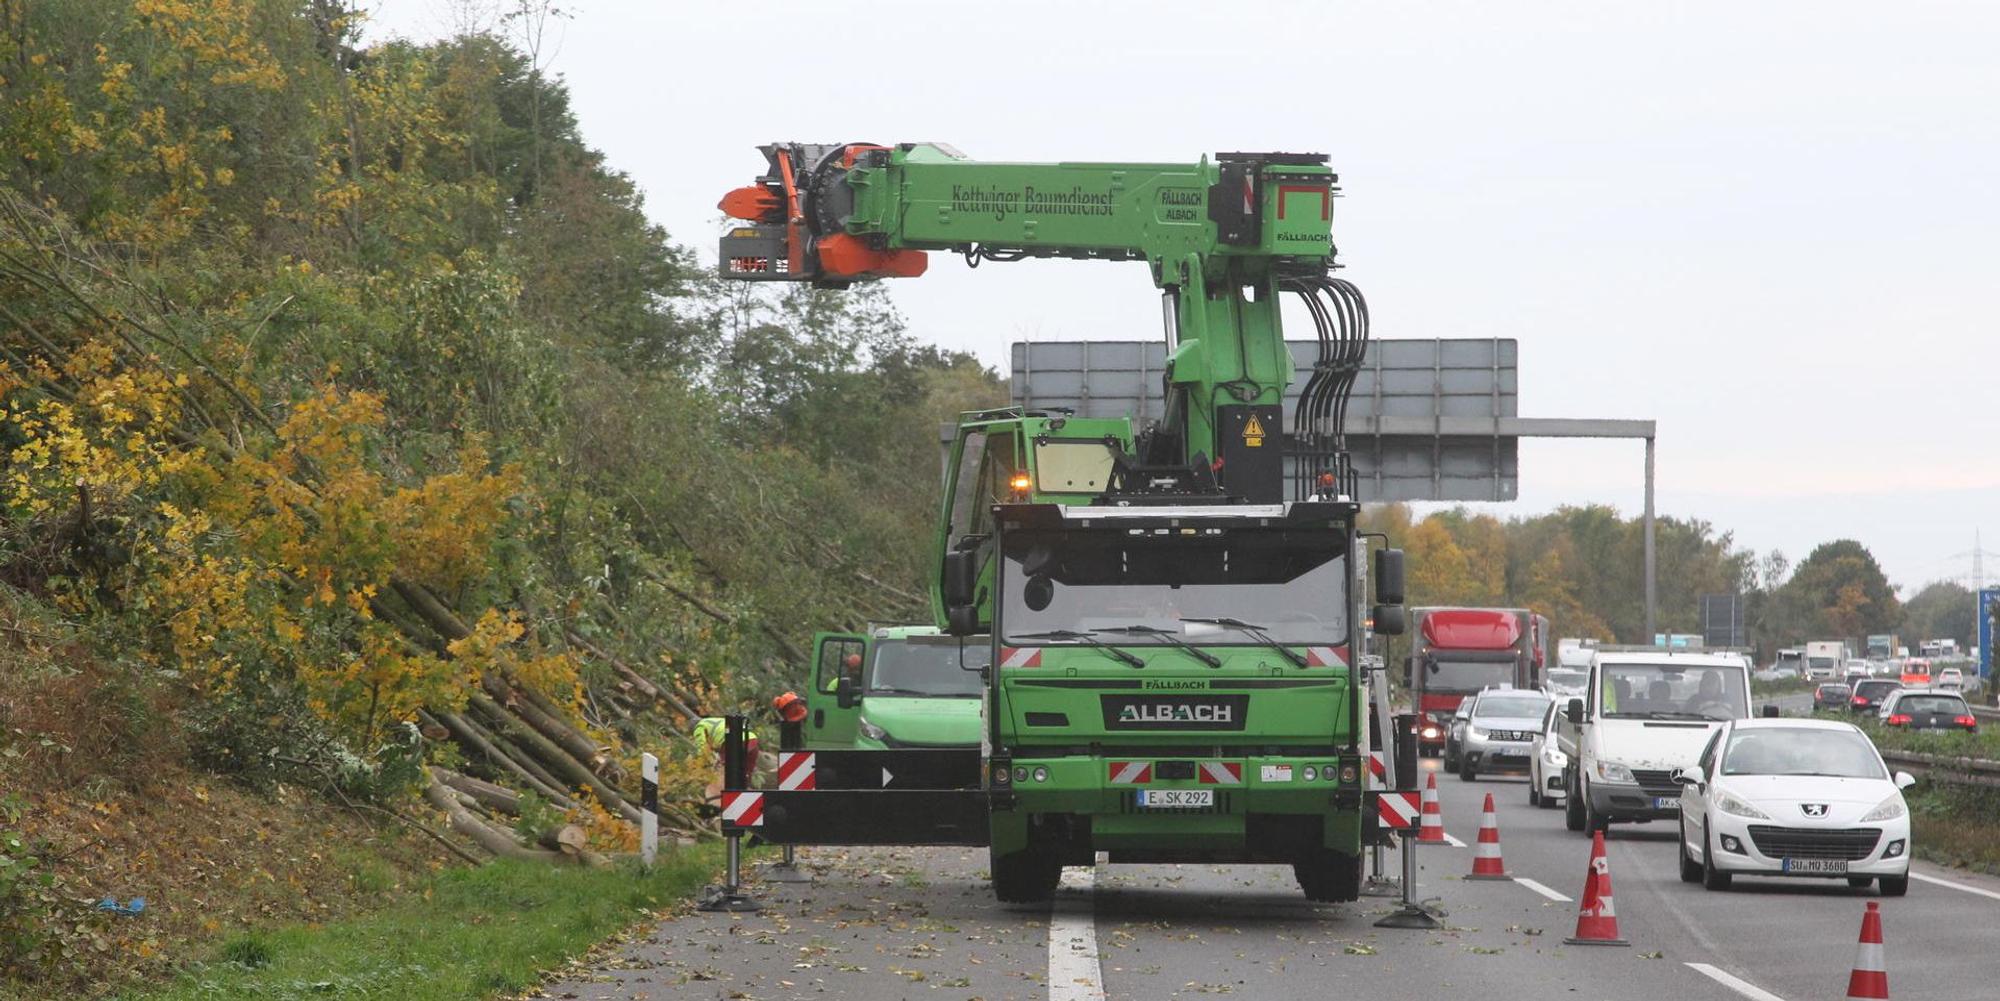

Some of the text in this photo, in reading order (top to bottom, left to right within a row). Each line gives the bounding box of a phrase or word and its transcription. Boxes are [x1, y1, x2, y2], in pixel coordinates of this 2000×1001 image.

[952, 184, 1113, 221] Kettwiger Baumdienst
[1161, 189, 1202, 206] FÄLLBACH
[1167, 209, 1197, 220] ALBACH
[1277, 231, 1328, 241] FÄLLBACH
[1146, 680, 1205, 690] FÄLLBACH
[1120, 704, 1231, 722] ALBACH
[1149, 791, 1209, 804] E SK 292
